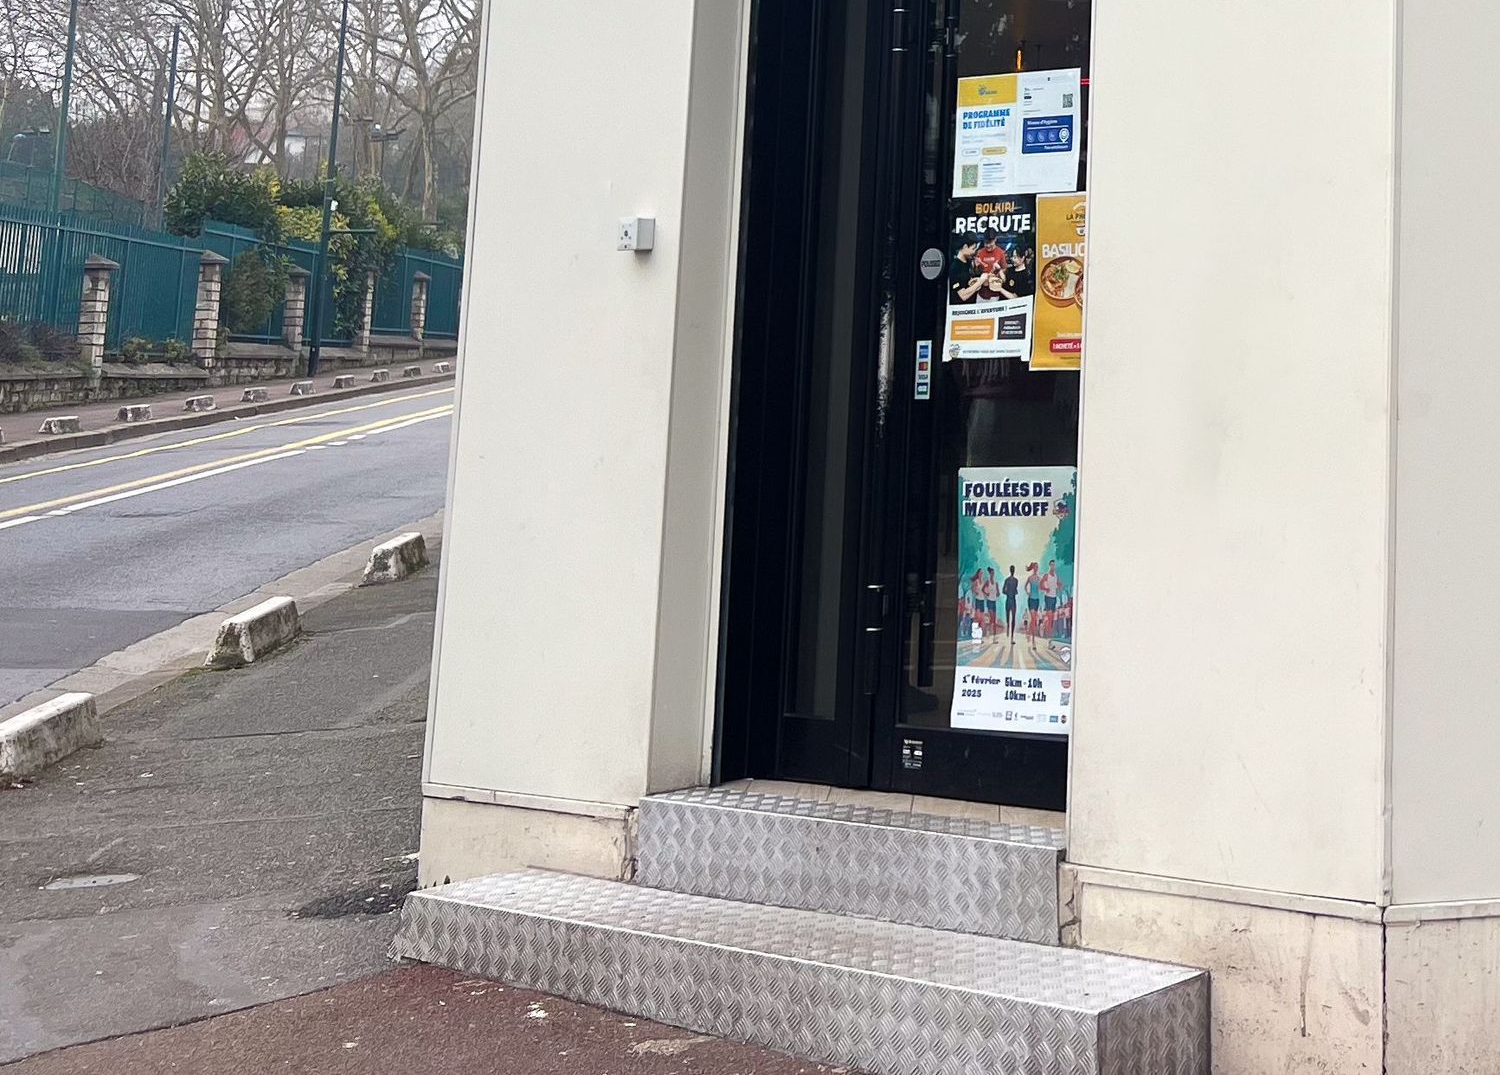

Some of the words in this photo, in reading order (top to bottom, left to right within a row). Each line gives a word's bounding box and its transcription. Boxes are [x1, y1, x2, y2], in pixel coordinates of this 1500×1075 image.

[962, 108, 1011, 120] PROGRAMME
[962, 121, 973, 130] DE
[973, 118, 1006, 129] FIDÉLITÉ
[975, 201, 1016, 215] BOLKIRI
[955, 213, 1031, 235] RECRUTE
[965, 478, 1030, 497] FOULÉES
[1032, 482, 1052, 497] DE
[964, 501, 1049, 517] MALAKOFF
[1027, 677, 1043, 689] 10h
[961, 689, 982, 698] 2025
[1004, 690, 1026, 701] 10km
[1031, 691, 1047, 702] 11h
